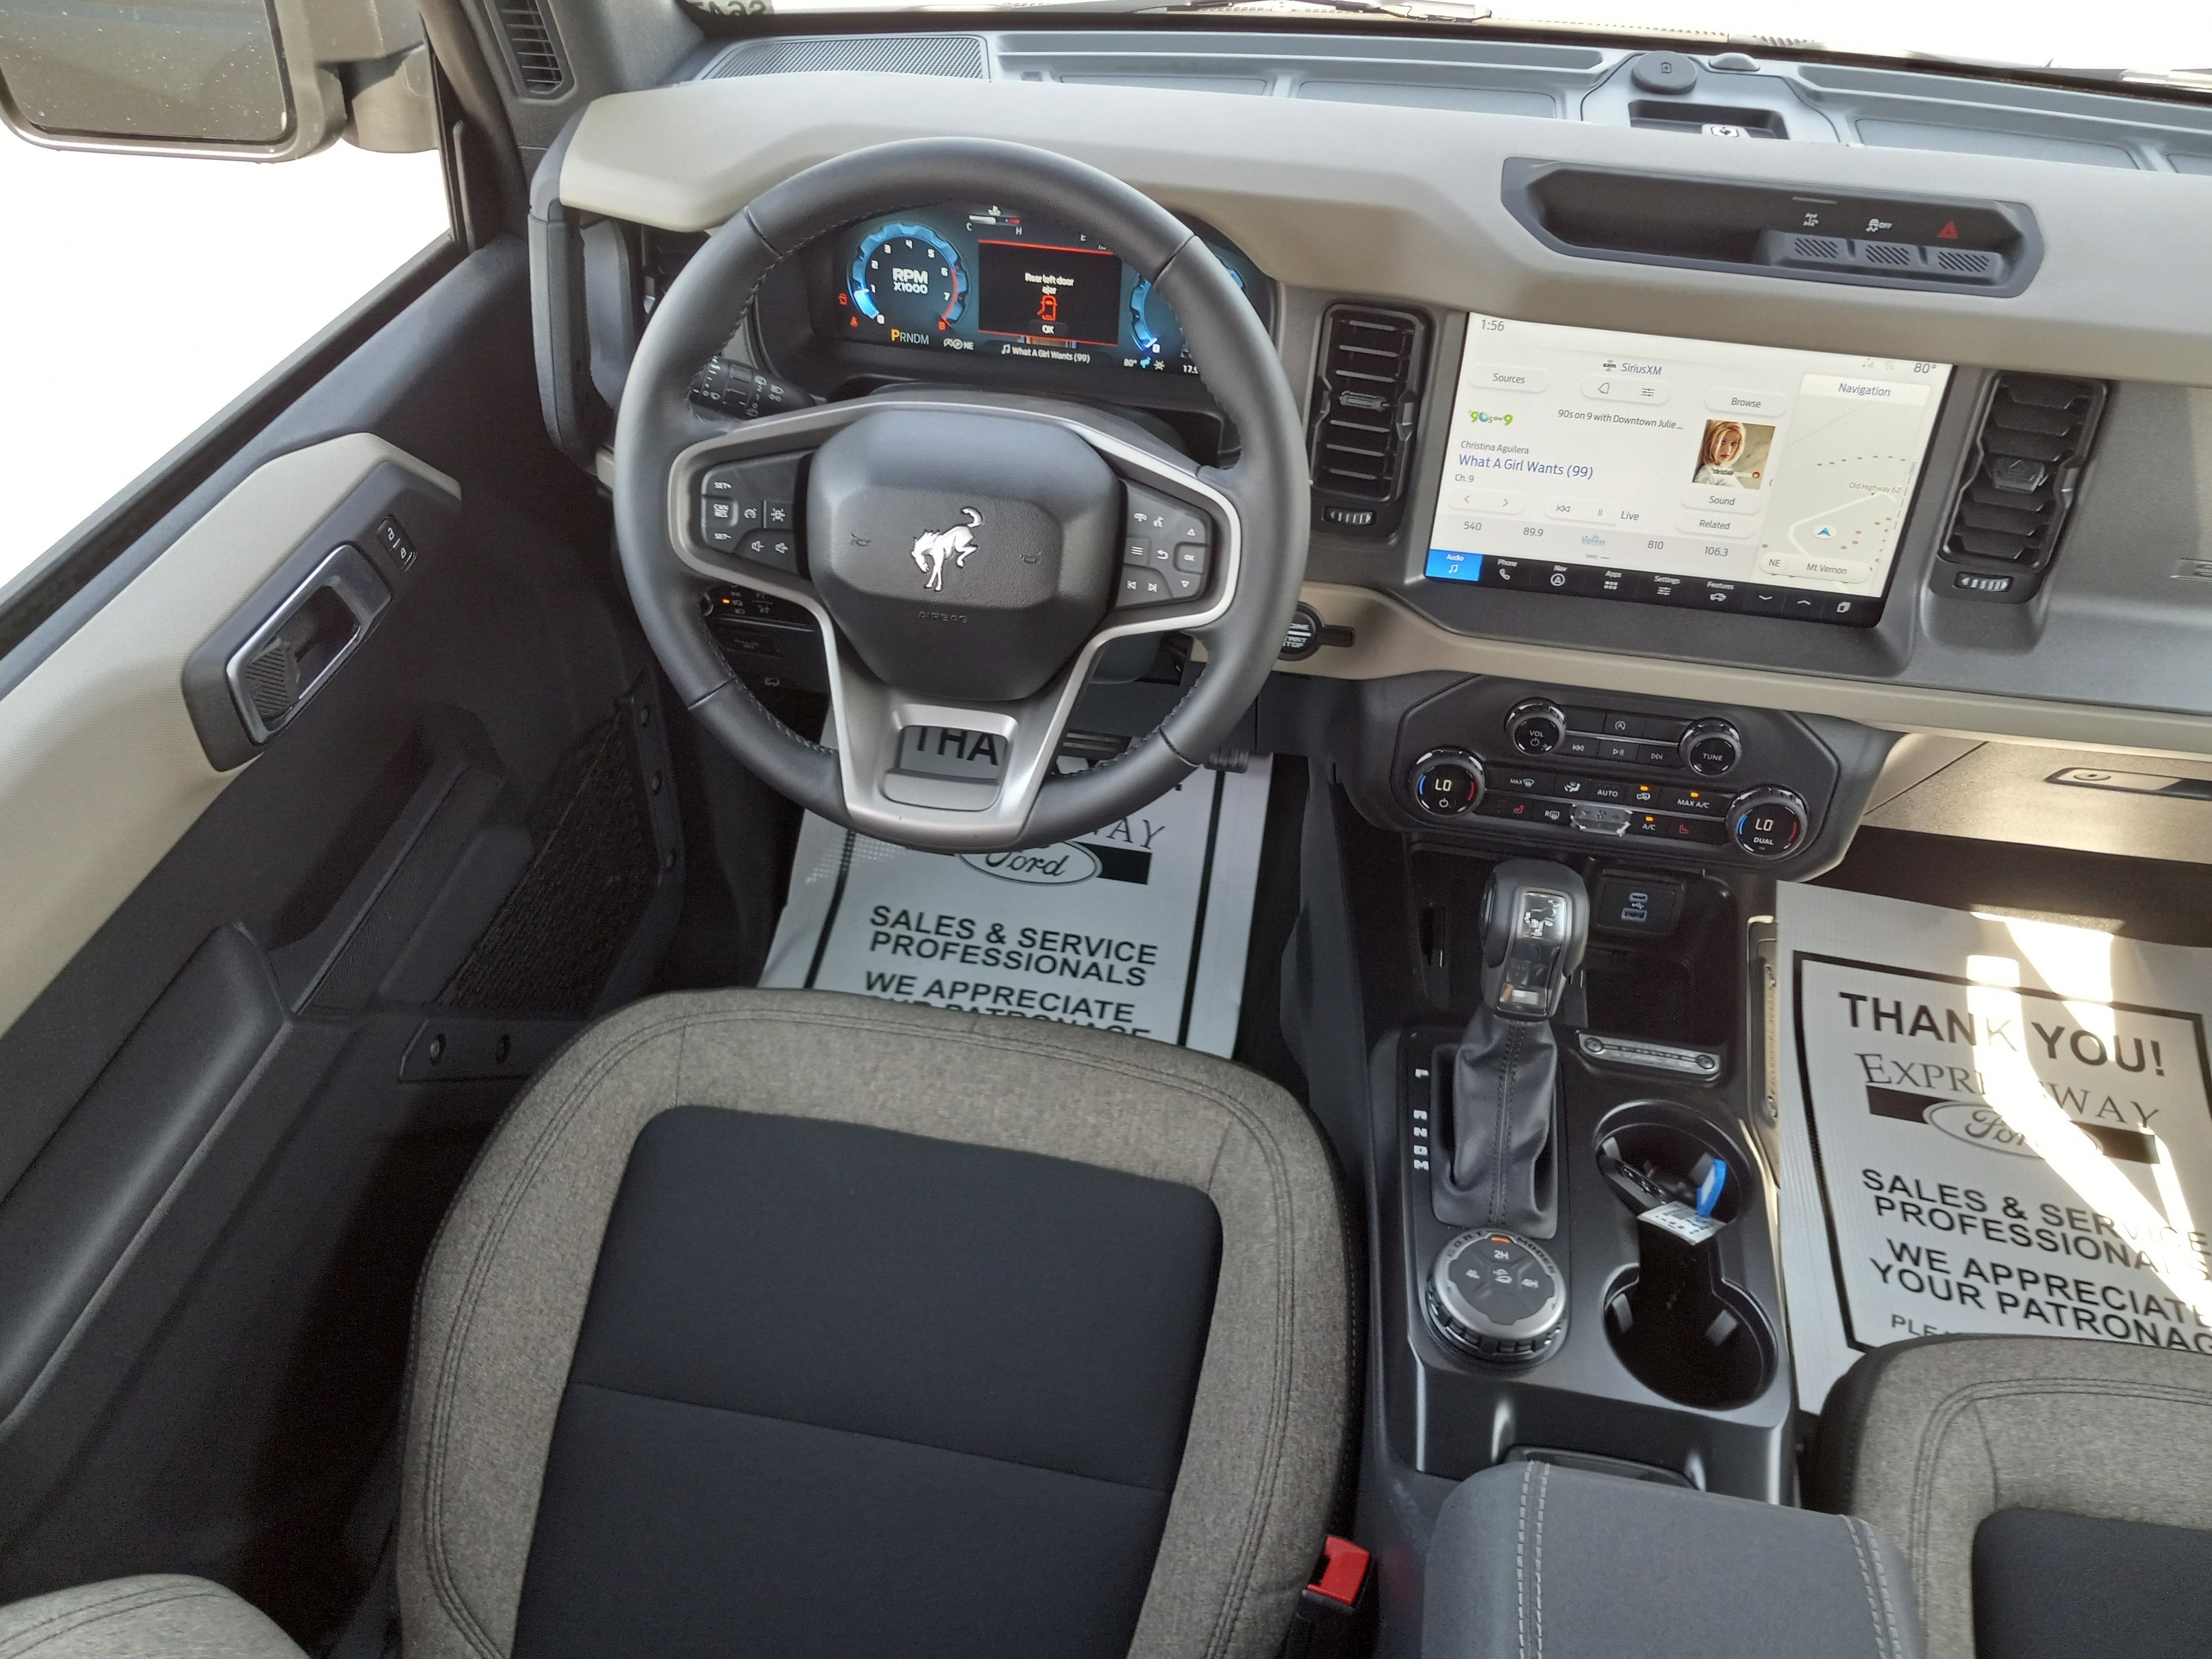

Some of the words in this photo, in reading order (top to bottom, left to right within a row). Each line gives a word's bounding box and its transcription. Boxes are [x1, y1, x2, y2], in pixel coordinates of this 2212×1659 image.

[966, 222, 973, 231] C
[1016, 227, 1022, 235] H
[884, 244, 891, 254] 3
[905, 240, 913, 249] 4
[927, 249, 935, 258] 5
[871, 260, 878, 269] 2
[892, 268, 928, 284] RPM
[941, 267, 948, 276] 6
[1025, 272, 1042, 284] Rear
[1042, 274, 1056, 285] left
[1056, 276, 1074, 287] door
[870, 284, 876, 294] 1
[943, 292, 950, 301] 7
[877, 314, 885, 324] 0
[1042, 325, 1054, 334] OK
[1481, 319, 1504, 332] 1:56
[963, 341, 974, 350] NE
[1153, 344, 1160, 353] 0
[1012, 346, 1031, 357] What
[1032, 349, 1038, 357] A
[1051, 351, 1073, 361] Wants
[1073, 353, 1090, 363] (99)
[1621, 363, 1662, 376] SiriusXM
[1914, 362, 1936, 373] 80°
[1493, 373, 1526, 385] Sources
[1838, 383, 1891, 397] Navigation
[1731, 397, 1761, 409] Browse
[1558, 409, 1575, 420] 90s
[1575, 412, 1585, 421] on
[1587, 412, 1593, 421] 9
[1593, 413, 1612, 423] with
[1613, 415, 1657, 428] Downtown
[1461, 440, 1495, 452] Christina
[1496, 443, 1529, 455] Aguilera
[1459, 454, 1491, 468] What
[1493, 457, 1501, 469] A
[1504, 458, 1524, 471] Girl
[1527, 462, 1564, 476] Wants
[1567, 464, 1594, 480] (99)
[1455, 473, 1467, 482] Ch.
[1469, 474, 1475, 482] 9
[1849, 481, 1860, 490] Old
[1860, 483, 1891, 494] Highway
[1709, 495, 1735, 506] Sound
[1621, 511, 1639, 521] Live
[1464, 521, 1482, 531] 540
[1699, 519, 1731, 530] Related
[1523, 527, 1544, 537] 89.9
[1647, 540, 1664, 550] 810
[1705, 546, 1729, 557] 106.3
[1446, 553, 1464, 562] Audio
[1497, 559, 1518, 567] Phone
[1769, 559, 1781, 567] NE
[1807, 563, 1818, 572] Mt
[1819, 564, 1848, 575] Vernon
[1654, 576, 1681, 585] Settings
[1707, 581, 1734, 590] Features
[1529, 730, 1544, 738] VOL
[1703, 753, 1723, 762] TUNE
[1597, 789, 1618, 798] AUTO
[1677, 799, 1695, 807] MAX
[1695, 801, 1709, 809] A/C
[1753, 837, 1774, 845] DUAL
[870, 905, 976, 939] SALES
[986, 923, 1008, 945] &
[1019, 927, 1158, 965] SERVICE
[870, 931, 1147, 986] PROFESSIONALS
[866, 971, 918, 995] WE
[924, 979, 1135, 1023] APPRECIATE
[1839, 992, 2018, 1052] THANK
[2031, 1022, 2164, 1077] YOU!
[1965, 1109, 2029, 1146] For
[1863, 1168, 1987, 1214] SALES
[2003, 1197, 2027, 1221] &
[1494, 1250, 1509, 1260] 2H
[1887, 1238, 1951, 1275] WE
[1870, 1257, 1986, 1309] YOUR
[1891, 1313, 1949, 1336] PLE
